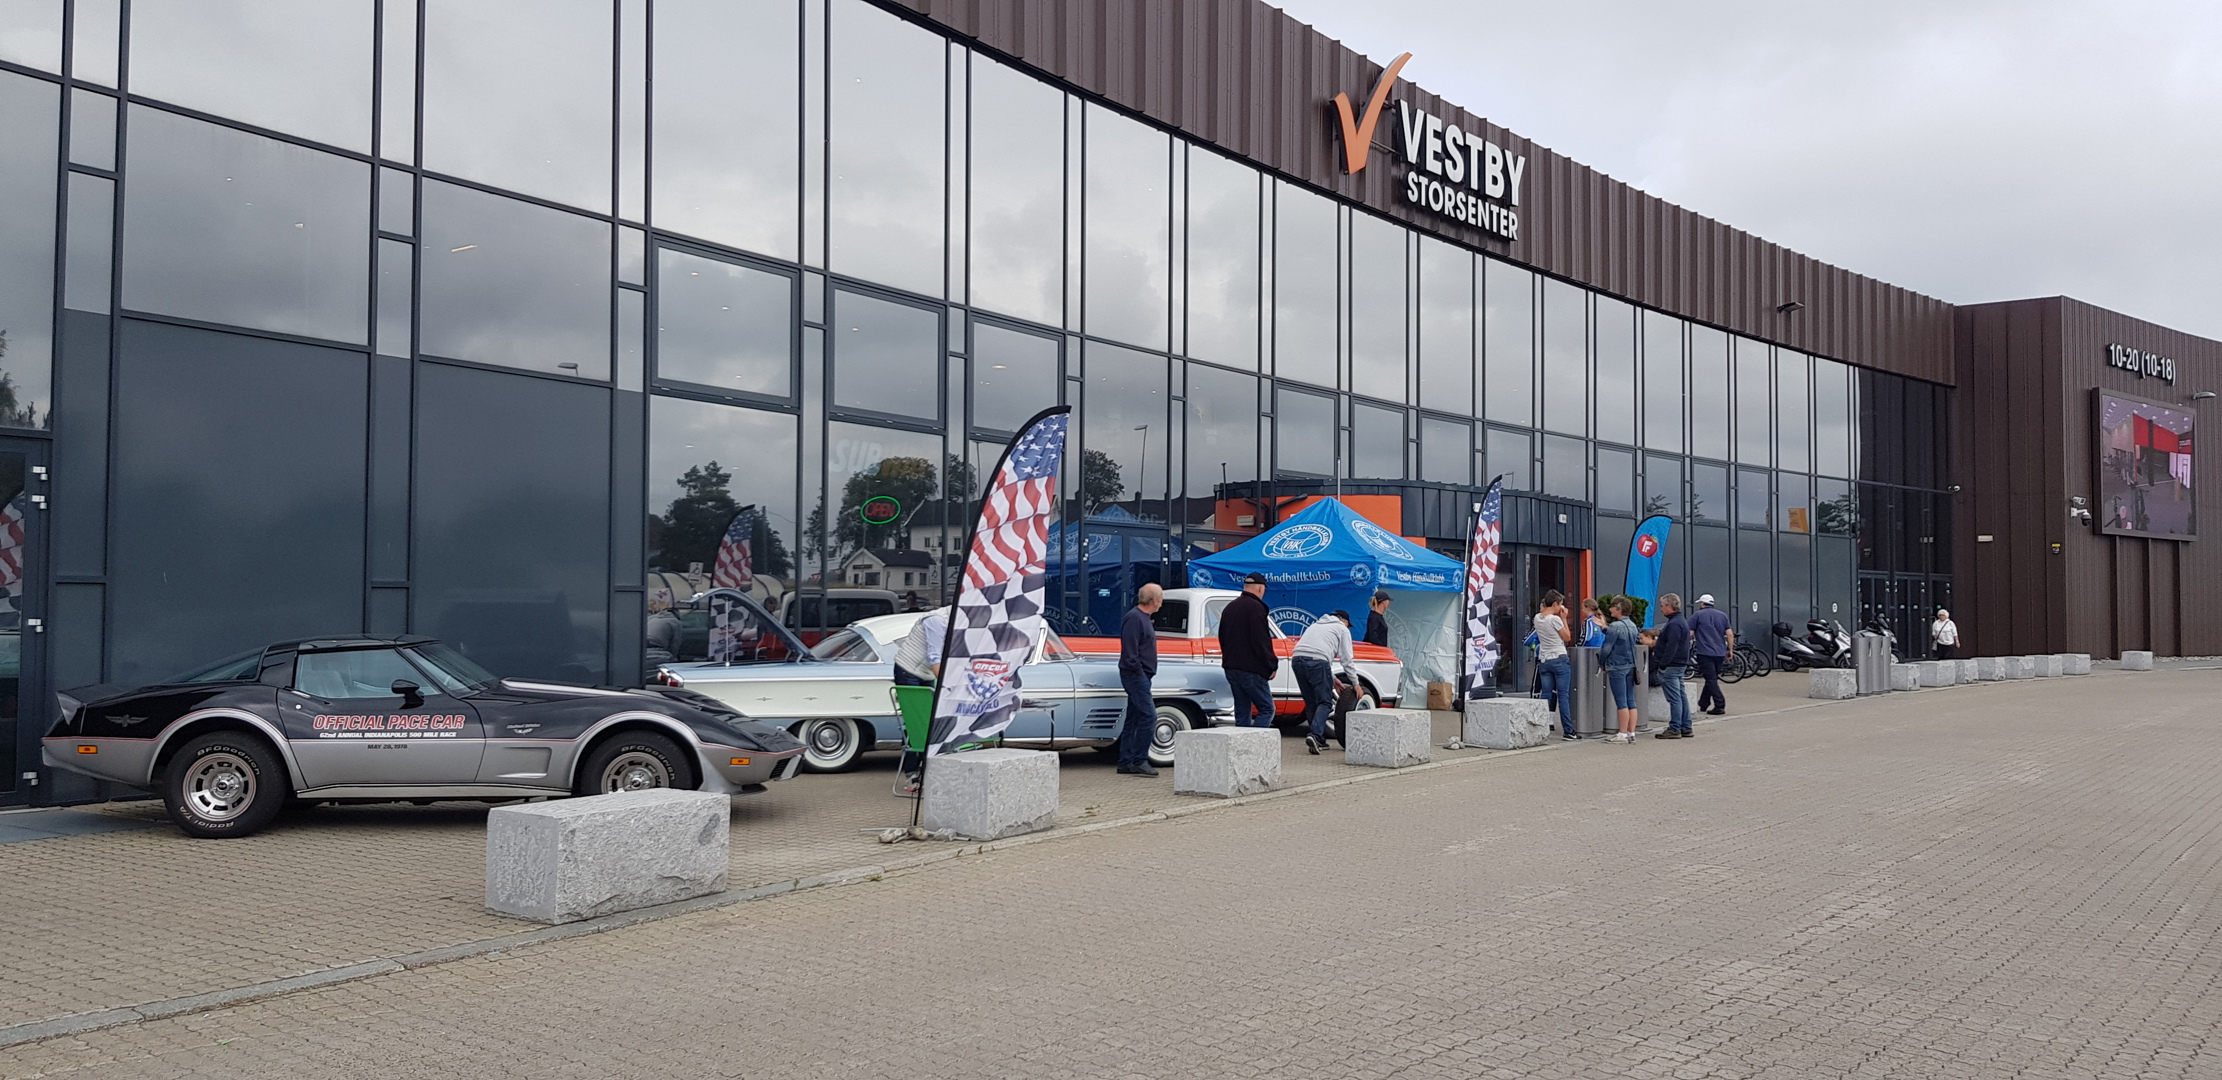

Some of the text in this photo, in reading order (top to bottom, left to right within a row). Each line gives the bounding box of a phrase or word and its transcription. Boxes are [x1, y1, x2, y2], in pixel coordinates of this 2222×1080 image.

[1400, 98, 1526, 207] VESTBY
[1407, 170, 1519, 241] STORSENTER
[2110, 343, 2176, 387] 10-20 (10-18)
[864, 502, 896, 517] OPEN
[1396, 570, 1412, 584] Vestby
[313, 714, 466, 730] OFFICIAL PACE CAR
[197, 745, 261, 775] BFGoodrich
[621, 745, 677, 780] BFGoodrich
[194, 820, 235, 828] Radial
